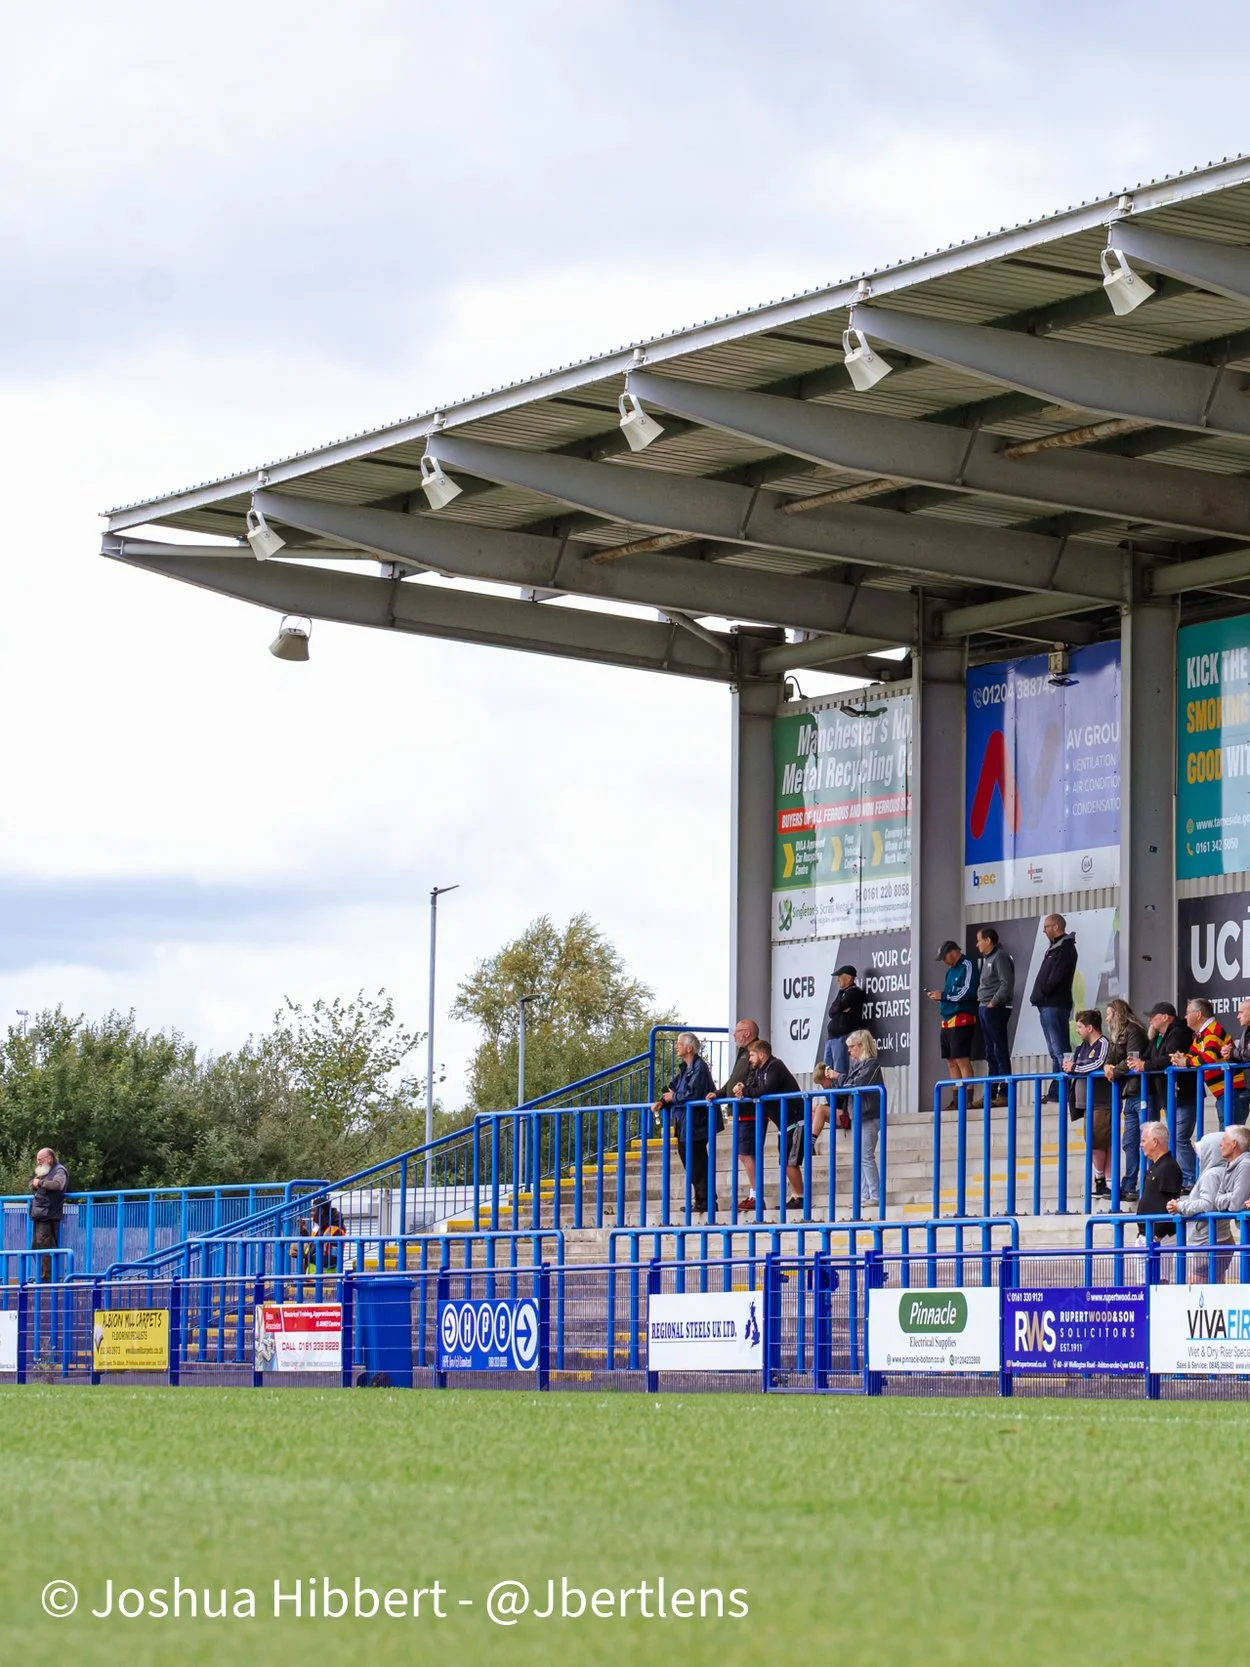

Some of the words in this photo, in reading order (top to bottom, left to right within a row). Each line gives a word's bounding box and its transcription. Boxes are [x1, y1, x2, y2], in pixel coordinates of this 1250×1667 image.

[1187, 652, 1219, 689] KICK
[1222, 647, 1248, 682] THE
[982, 684, 1014, 706] 01204
[1187, 692, 1250, 733] SMOKING
[797, 716, 889, 756] Manchester's
[1066, 729, 1082, 750] AV
[1073, 754, 1116, 772] VENTILATION
[1187, 748, 1224, 784] GOOD
[782, 759, 822, 795] Metal
[826, 750, 894, 792] Recycling
[782, 812, 803, 828] BUYERS
[1196, 842, 1210, 854] 0161
[973, 870, 996, 888] bpec
[863, 886, 878, 901] 0161
[880, 885, 892, 898] 220
[872, 950, 898, 968] YOUR
[784, 976, 816, 1000] UCFB
[876, 999, 910, 1019] STARTS
[790, 1018, 810, 1040] GIS
[1090, 1292, 1144, 1304] www.rupertwood.co.uk
[102, 1313, 123, 1328] ALBION
[136, 1312, 162, 1328] CARPETS
[910, 1300, 956, 1325] Pinnacle
[652, 1322, 684, 1339] REGIONAL
[686, 1321, 710, 1338] STEELS
[712, 1321, 722, 1338] UK
[1015, 1310, 1056, 1352] RWS
[1060, 1328, 1134, 1338] SOLICITORS
[282, 1342, 296, 1350] CALL
[910, 1336, 934, 1348] Electrical
[935, 1336, 956, 1350] Supplies
[1188, 1346, 1200, 1357] Wet
[1200, 1346, 1206, 1357] &
[1207, 1346, 1218, 1360] Dry
[1220, 1346, 1234, 1358] Riser
